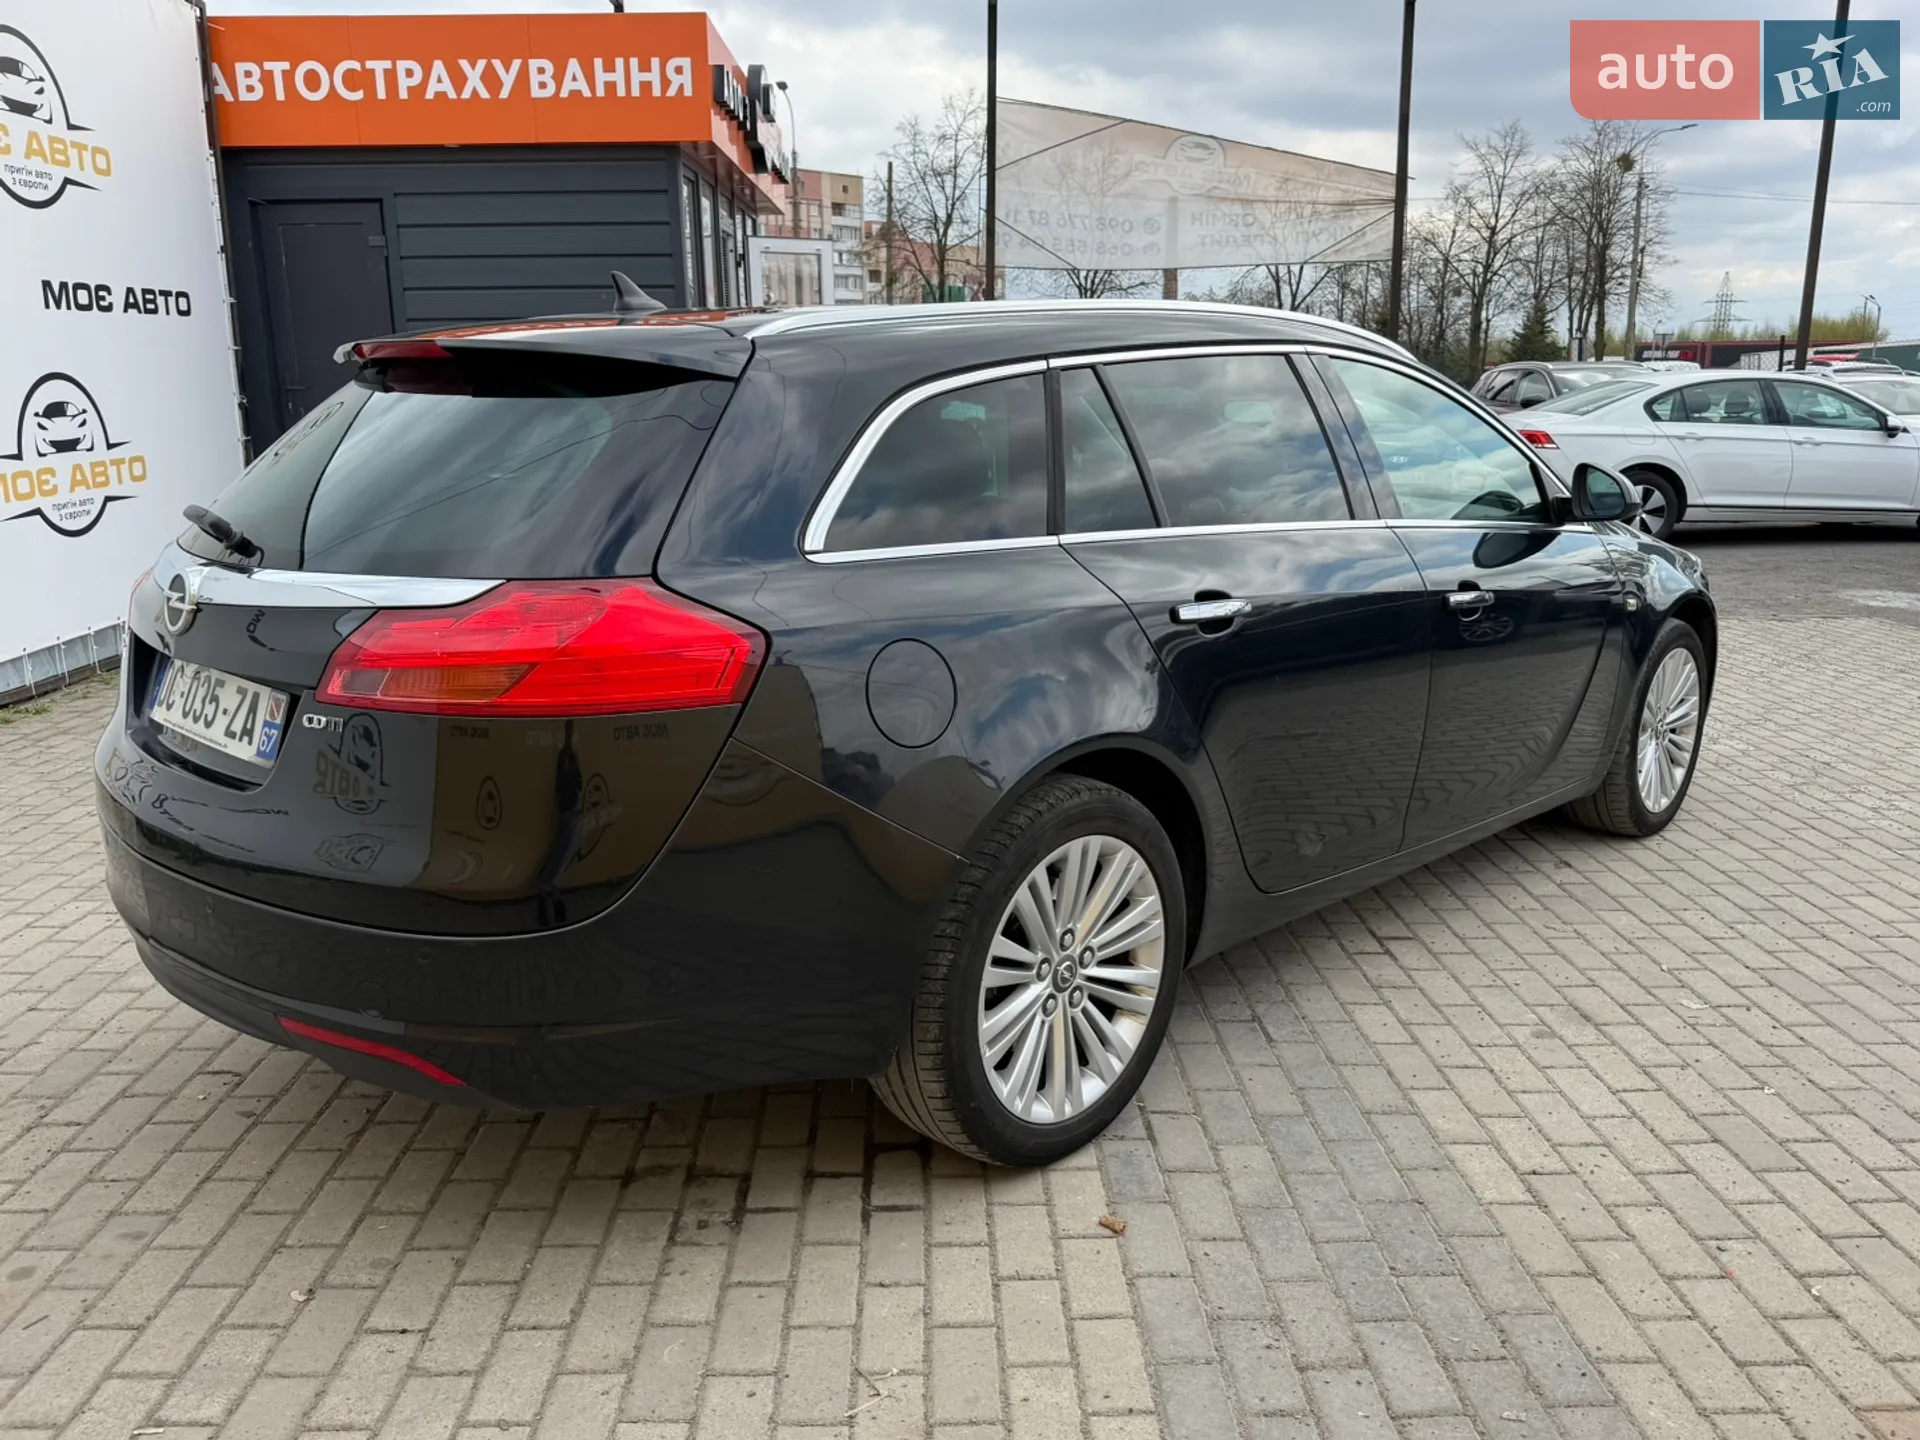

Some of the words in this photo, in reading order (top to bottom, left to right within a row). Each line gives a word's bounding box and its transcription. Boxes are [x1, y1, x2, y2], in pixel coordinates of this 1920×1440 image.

[211, 56, 693, 103] АВТОСТРАХУВАННЯ
[24, 130, 112, 177] АВТО
[34, 169, 53, 181] авто
[41, 280, 113, 312] МОЄ
[123, 286, 192, 317] АВТО
[69, 455, 147, 493] АВТО
[259, 727, 278, 753] 67
